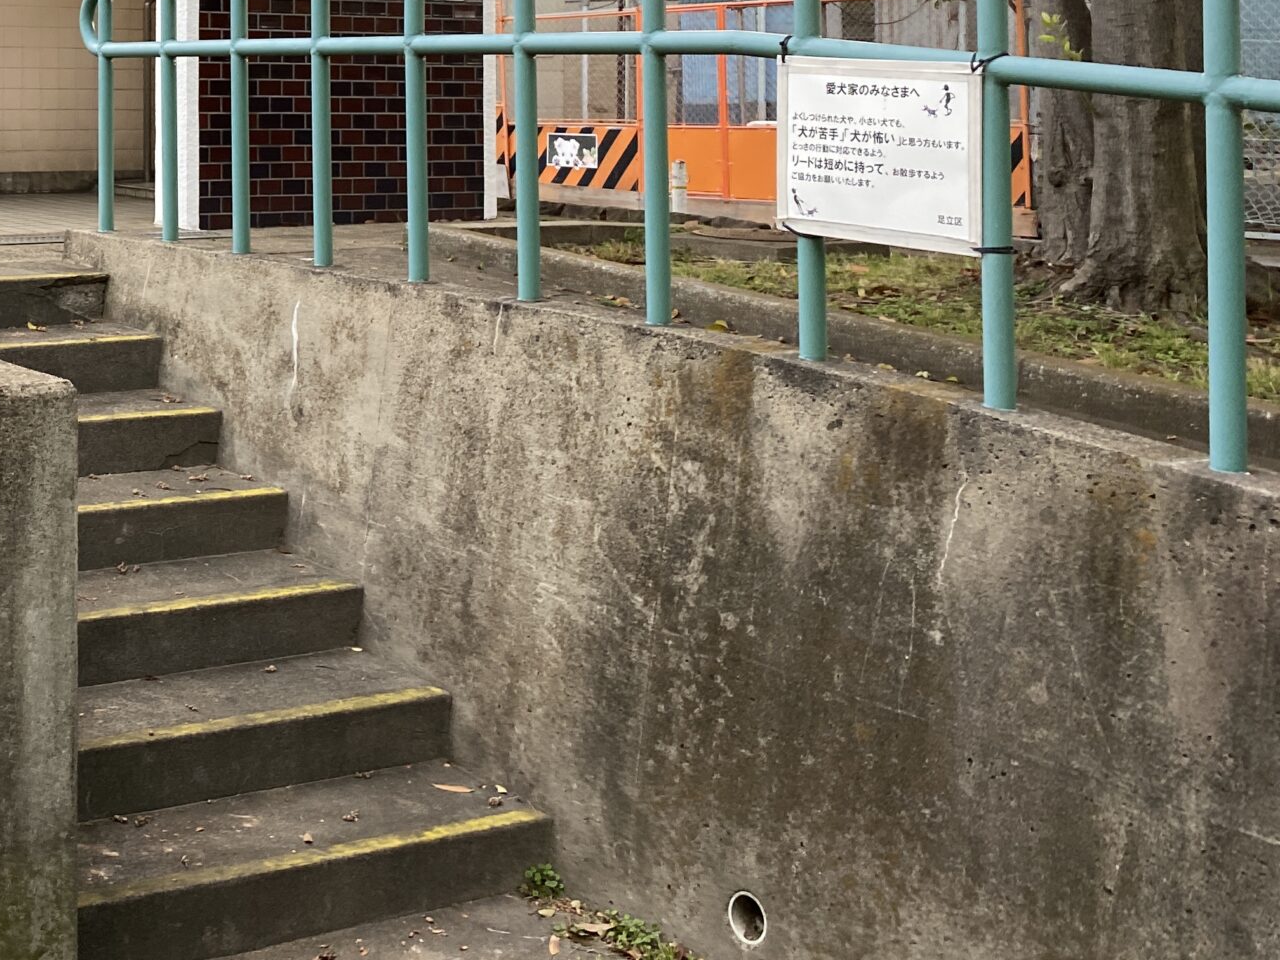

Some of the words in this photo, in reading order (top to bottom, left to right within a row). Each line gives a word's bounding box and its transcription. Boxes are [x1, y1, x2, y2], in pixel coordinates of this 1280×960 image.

[826, 82, 920, 98] 愛犬家のみなさまへ
[937, 214, 963, 227] 足立区
